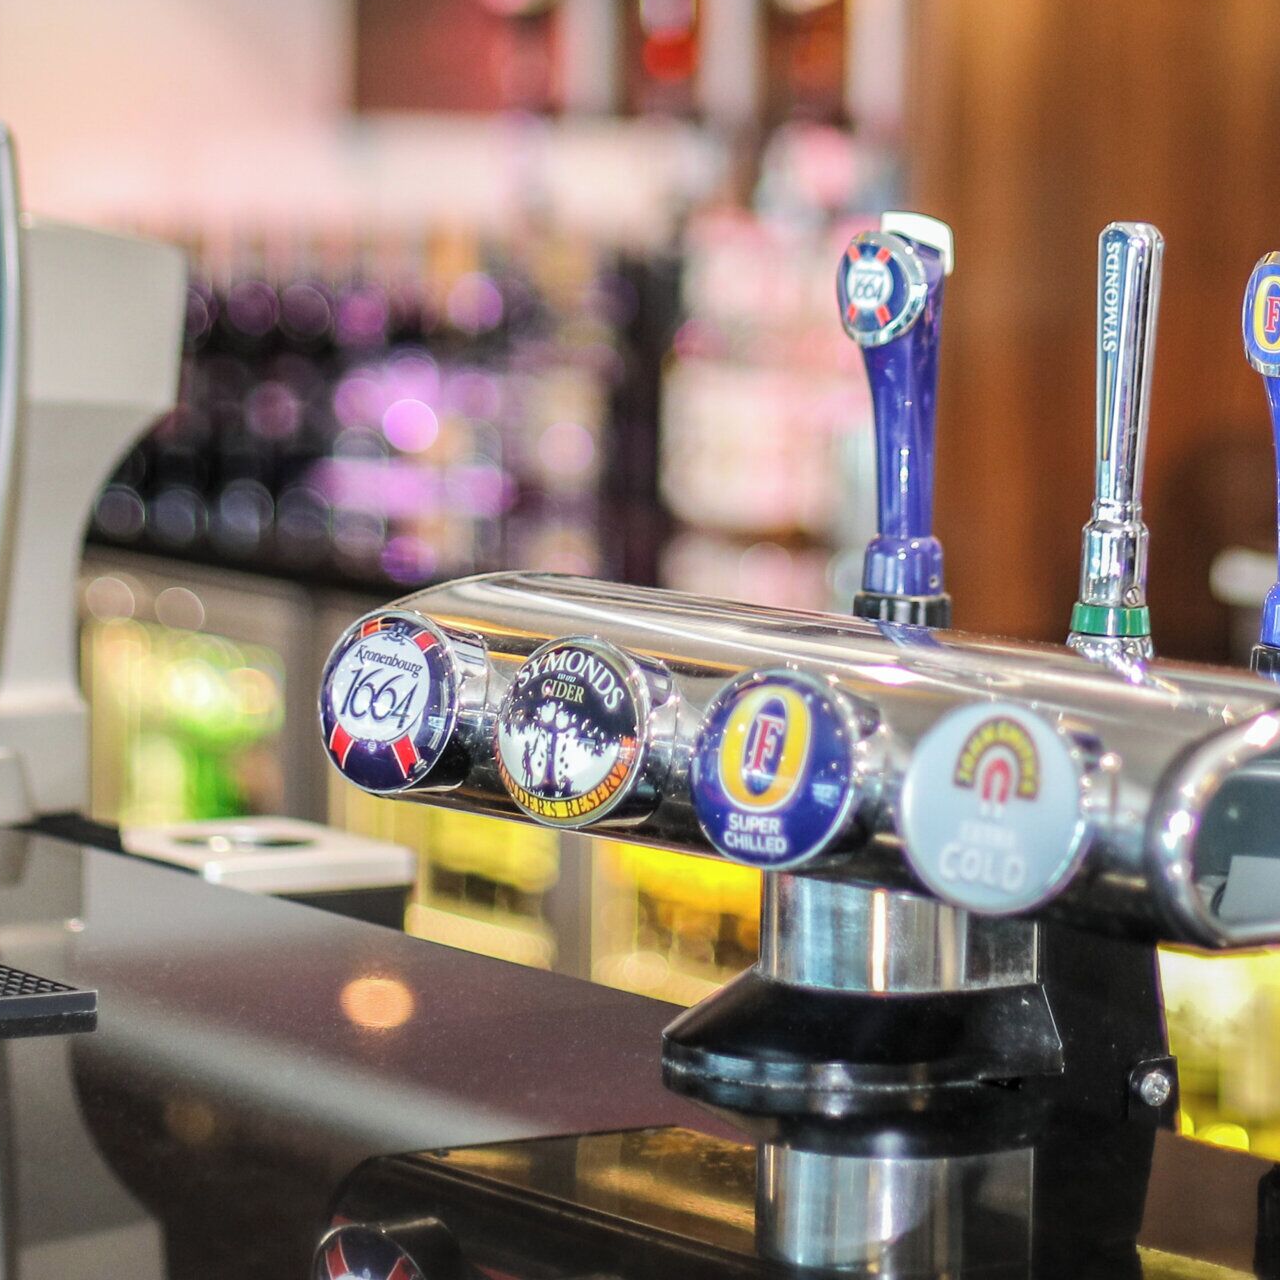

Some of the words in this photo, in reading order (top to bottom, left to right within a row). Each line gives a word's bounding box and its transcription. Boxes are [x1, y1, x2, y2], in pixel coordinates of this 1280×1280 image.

[1102, 240, 1121, 352] SYMONDS
[354, 644, 423, 679] Kronenbourg
[517, 650, 625, 710] SYMONDS
[340, 667, 419, 730] 1664
[541, 678, 586, 704] CIDER
[566, 746, 633, 818] RESERV
[723, 831, 788, 854] CHILLED
[729, 812, 781, 835] SUPER
[938, 841, 1025, 892] COLD
